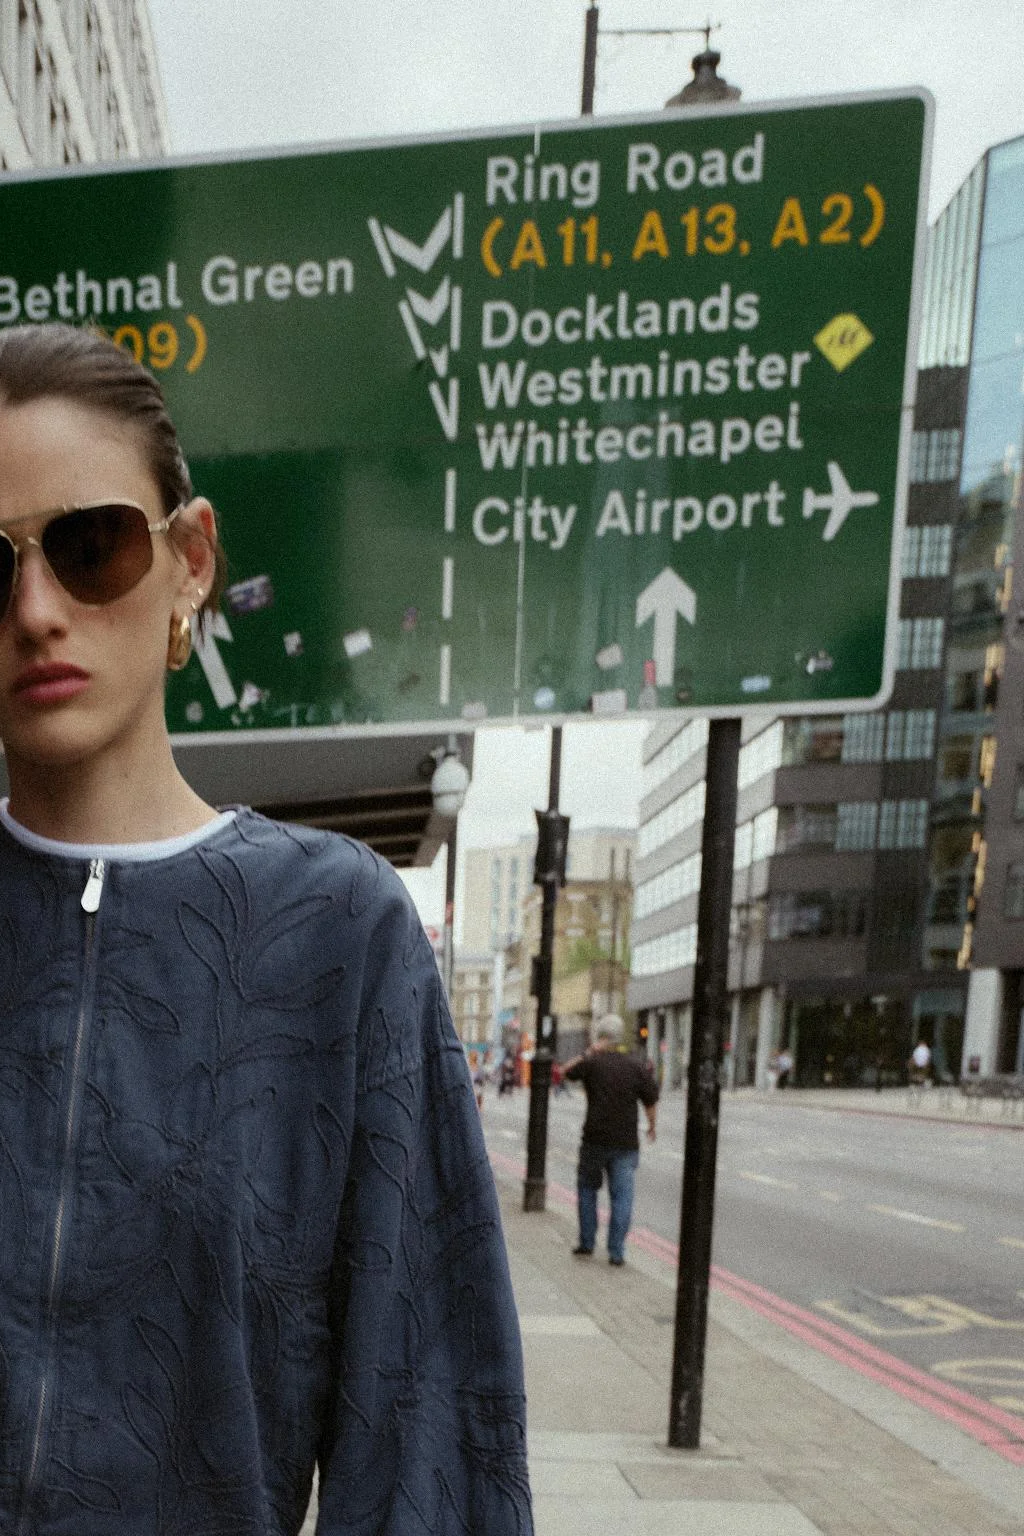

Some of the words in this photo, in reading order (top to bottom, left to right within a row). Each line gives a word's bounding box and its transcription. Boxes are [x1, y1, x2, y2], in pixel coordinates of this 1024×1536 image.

[485, 153, 601, 209] Ring
[626, 132, 766, 194] Road
[201, 255, 355, 305] Green
[481, 282, 761, 349] Docklands
[477, 344, 812, 411] Westminster
[476, 401, 805, 471] Whitechapel
[472, 496, 577, 550] City
[596, 480, 787, 542] Airport
